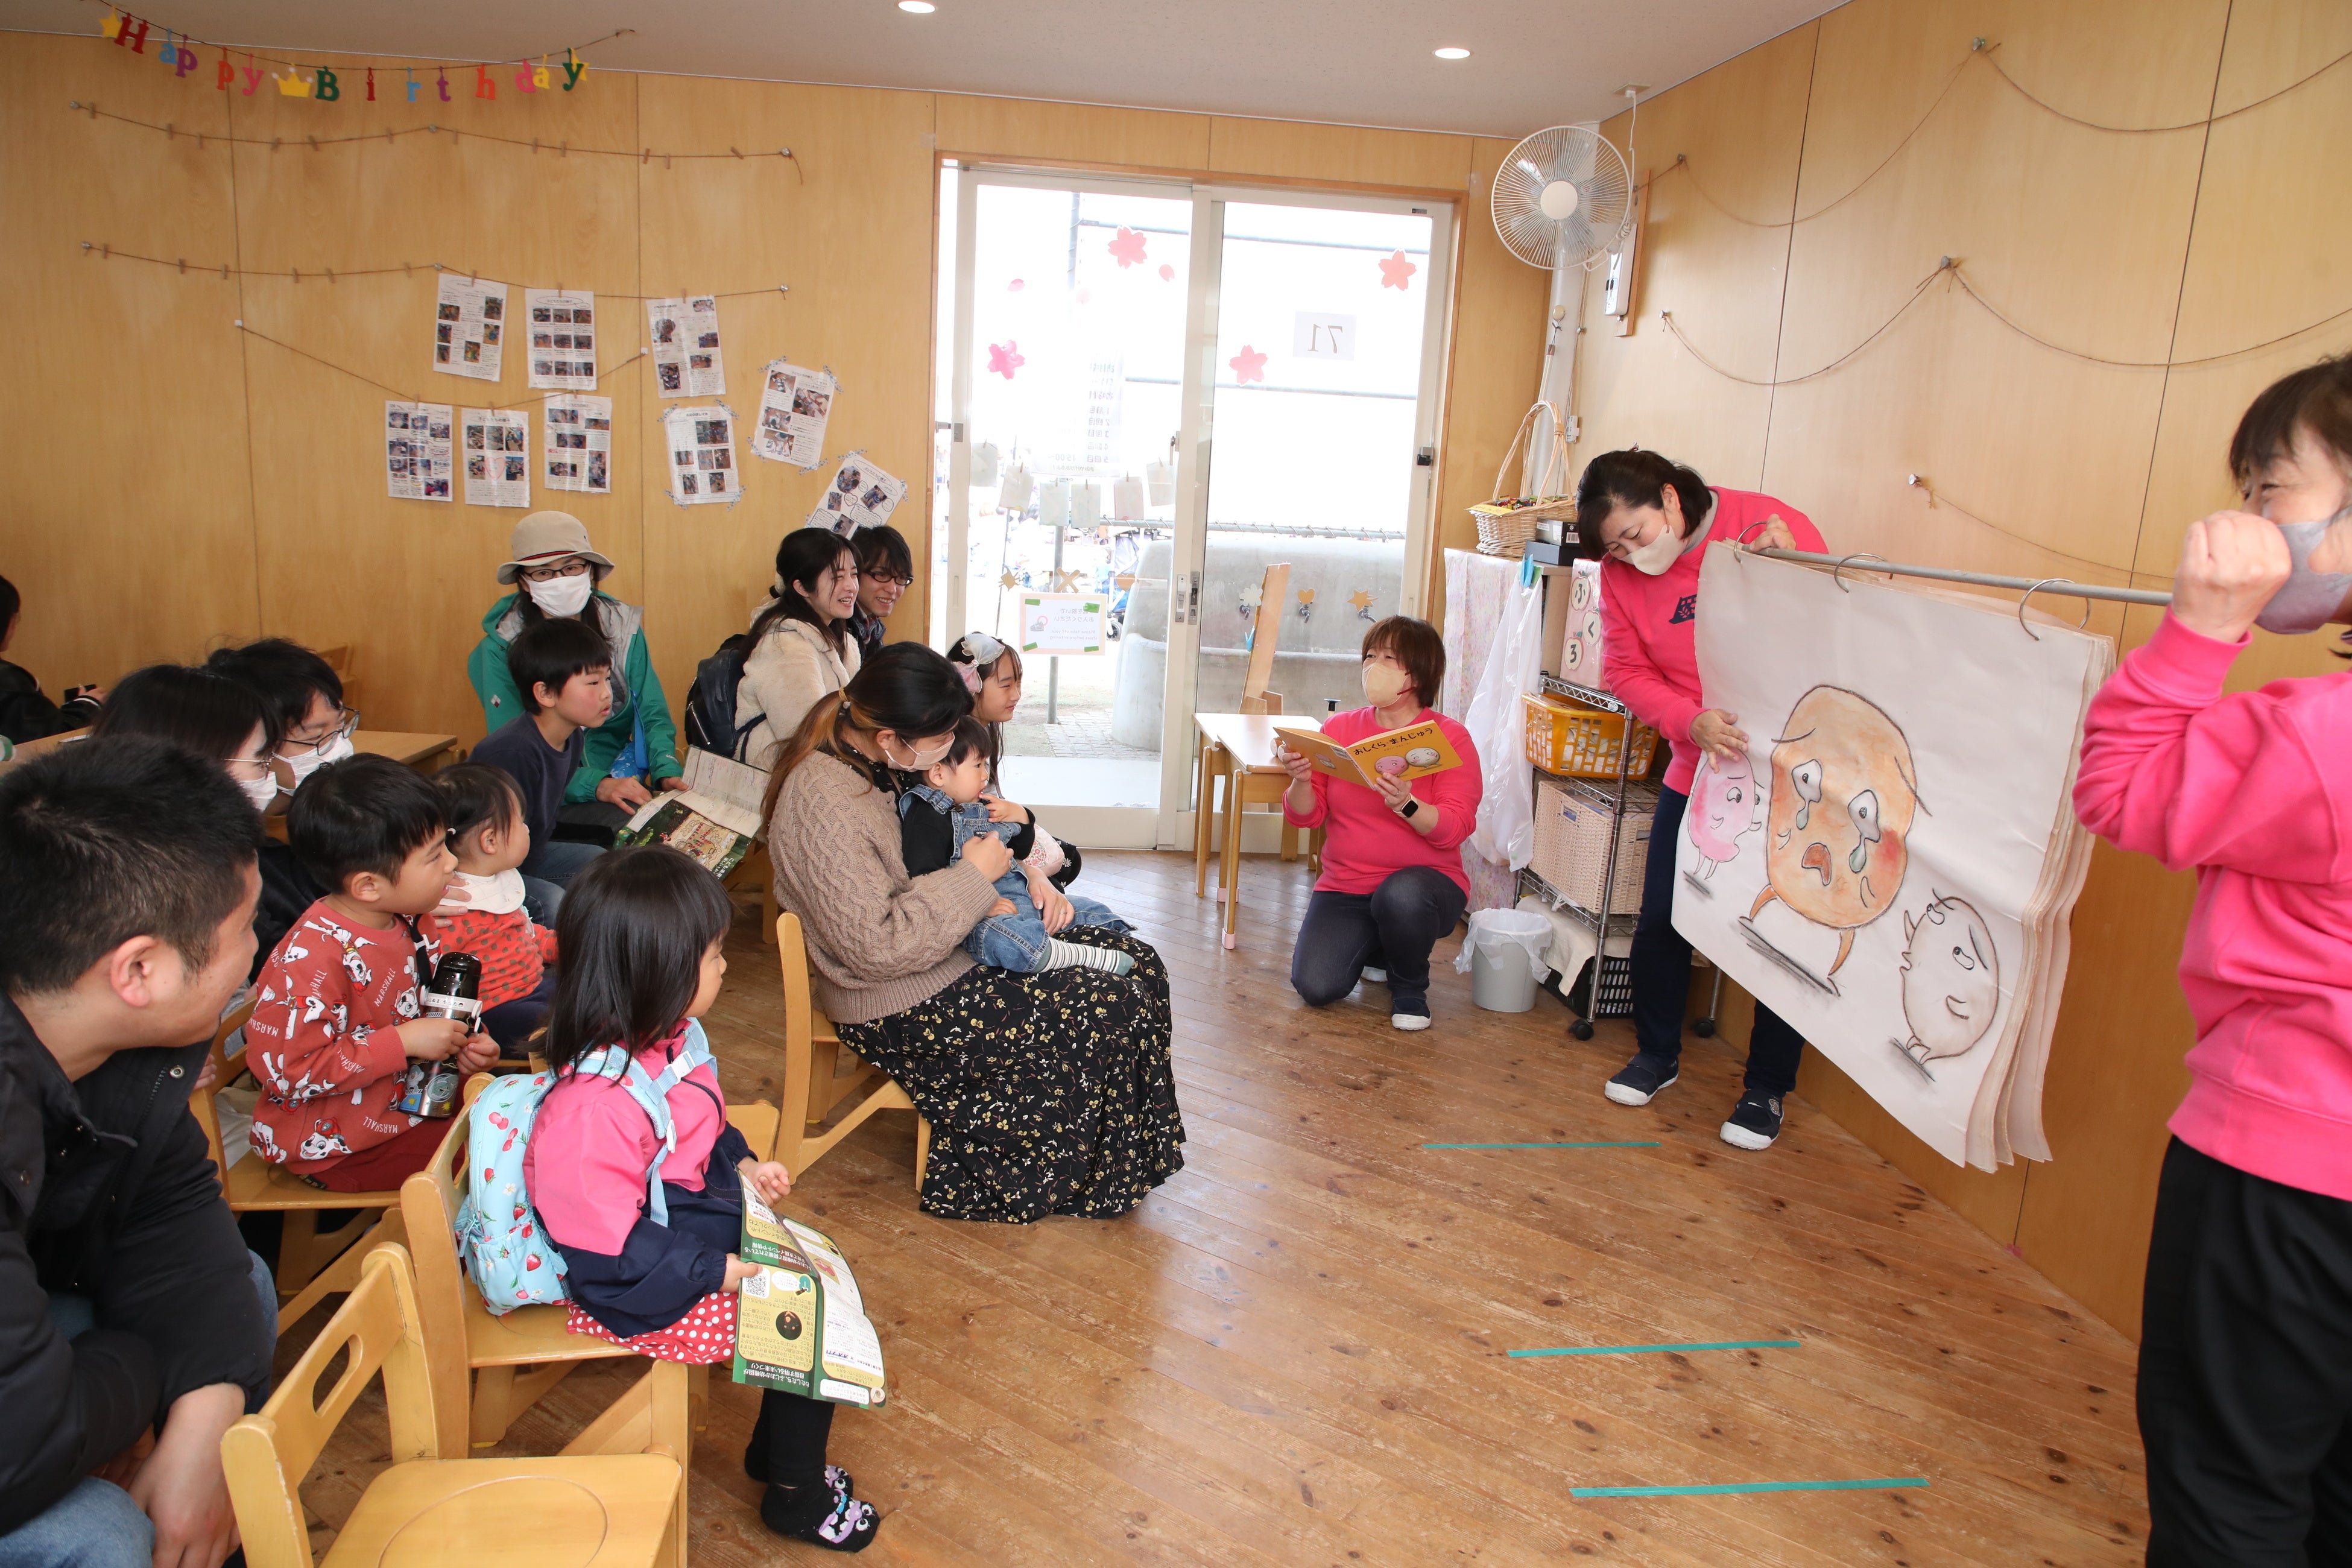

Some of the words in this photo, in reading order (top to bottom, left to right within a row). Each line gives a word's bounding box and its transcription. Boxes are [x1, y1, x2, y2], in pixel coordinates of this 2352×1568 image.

[113, 15, 264, 96] Happy
[315, 58, 584, 102] Birthday
[374, 967, 396, 1007] MARSHALL
[362, 1116, 398, 1134] MARSHALL
[743, 1368, 810, 1388] わたしたち、ふじおか幼稚園が
[751, 1363, 805, 1379] 目指す明るい未来づくり
